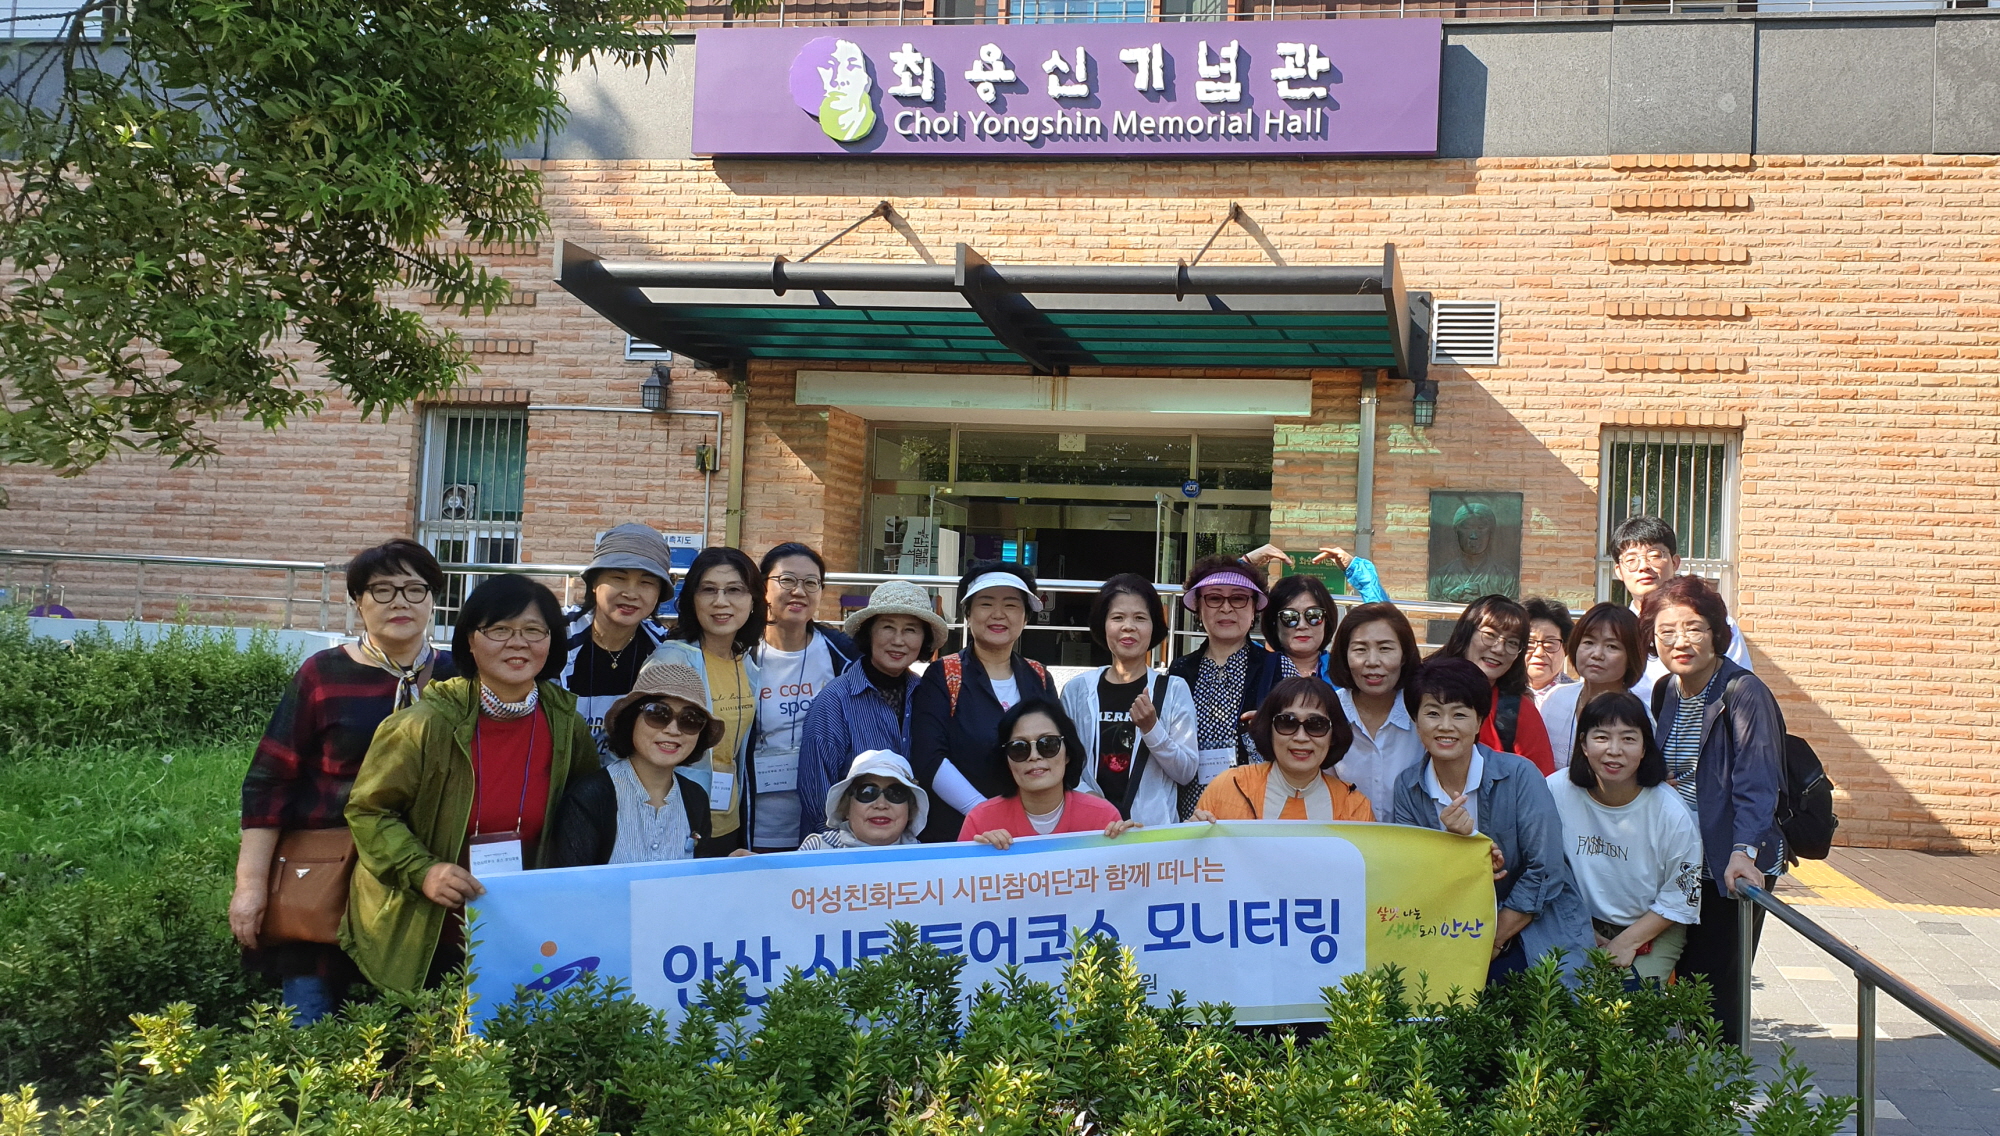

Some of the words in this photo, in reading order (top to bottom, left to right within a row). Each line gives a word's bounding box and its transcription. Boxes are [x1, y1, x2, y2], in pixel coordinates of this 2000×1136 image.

[893, 110, 960, 135] Choi
[967, 109, 1102, 141] Yongshin
[1112, 108, 1253, 135] Memorial
[1264, 107, 1322, 135] Hall
[1185, 484, 1197, 492] ADT
[780, 682, 814, 698] coq
[780, 700, 815, 717] spo
[791, 878, 944, 915] 여성친화도시
[952, 866, 1100, 904] 시민참여단과
[1104, 861, 1151, 891] 함께
[1156, 856, 1226, 885] 떠나는
[662, 935, 782, 1010] 안산
[1143, 897, 1341, 965] 모니터링
